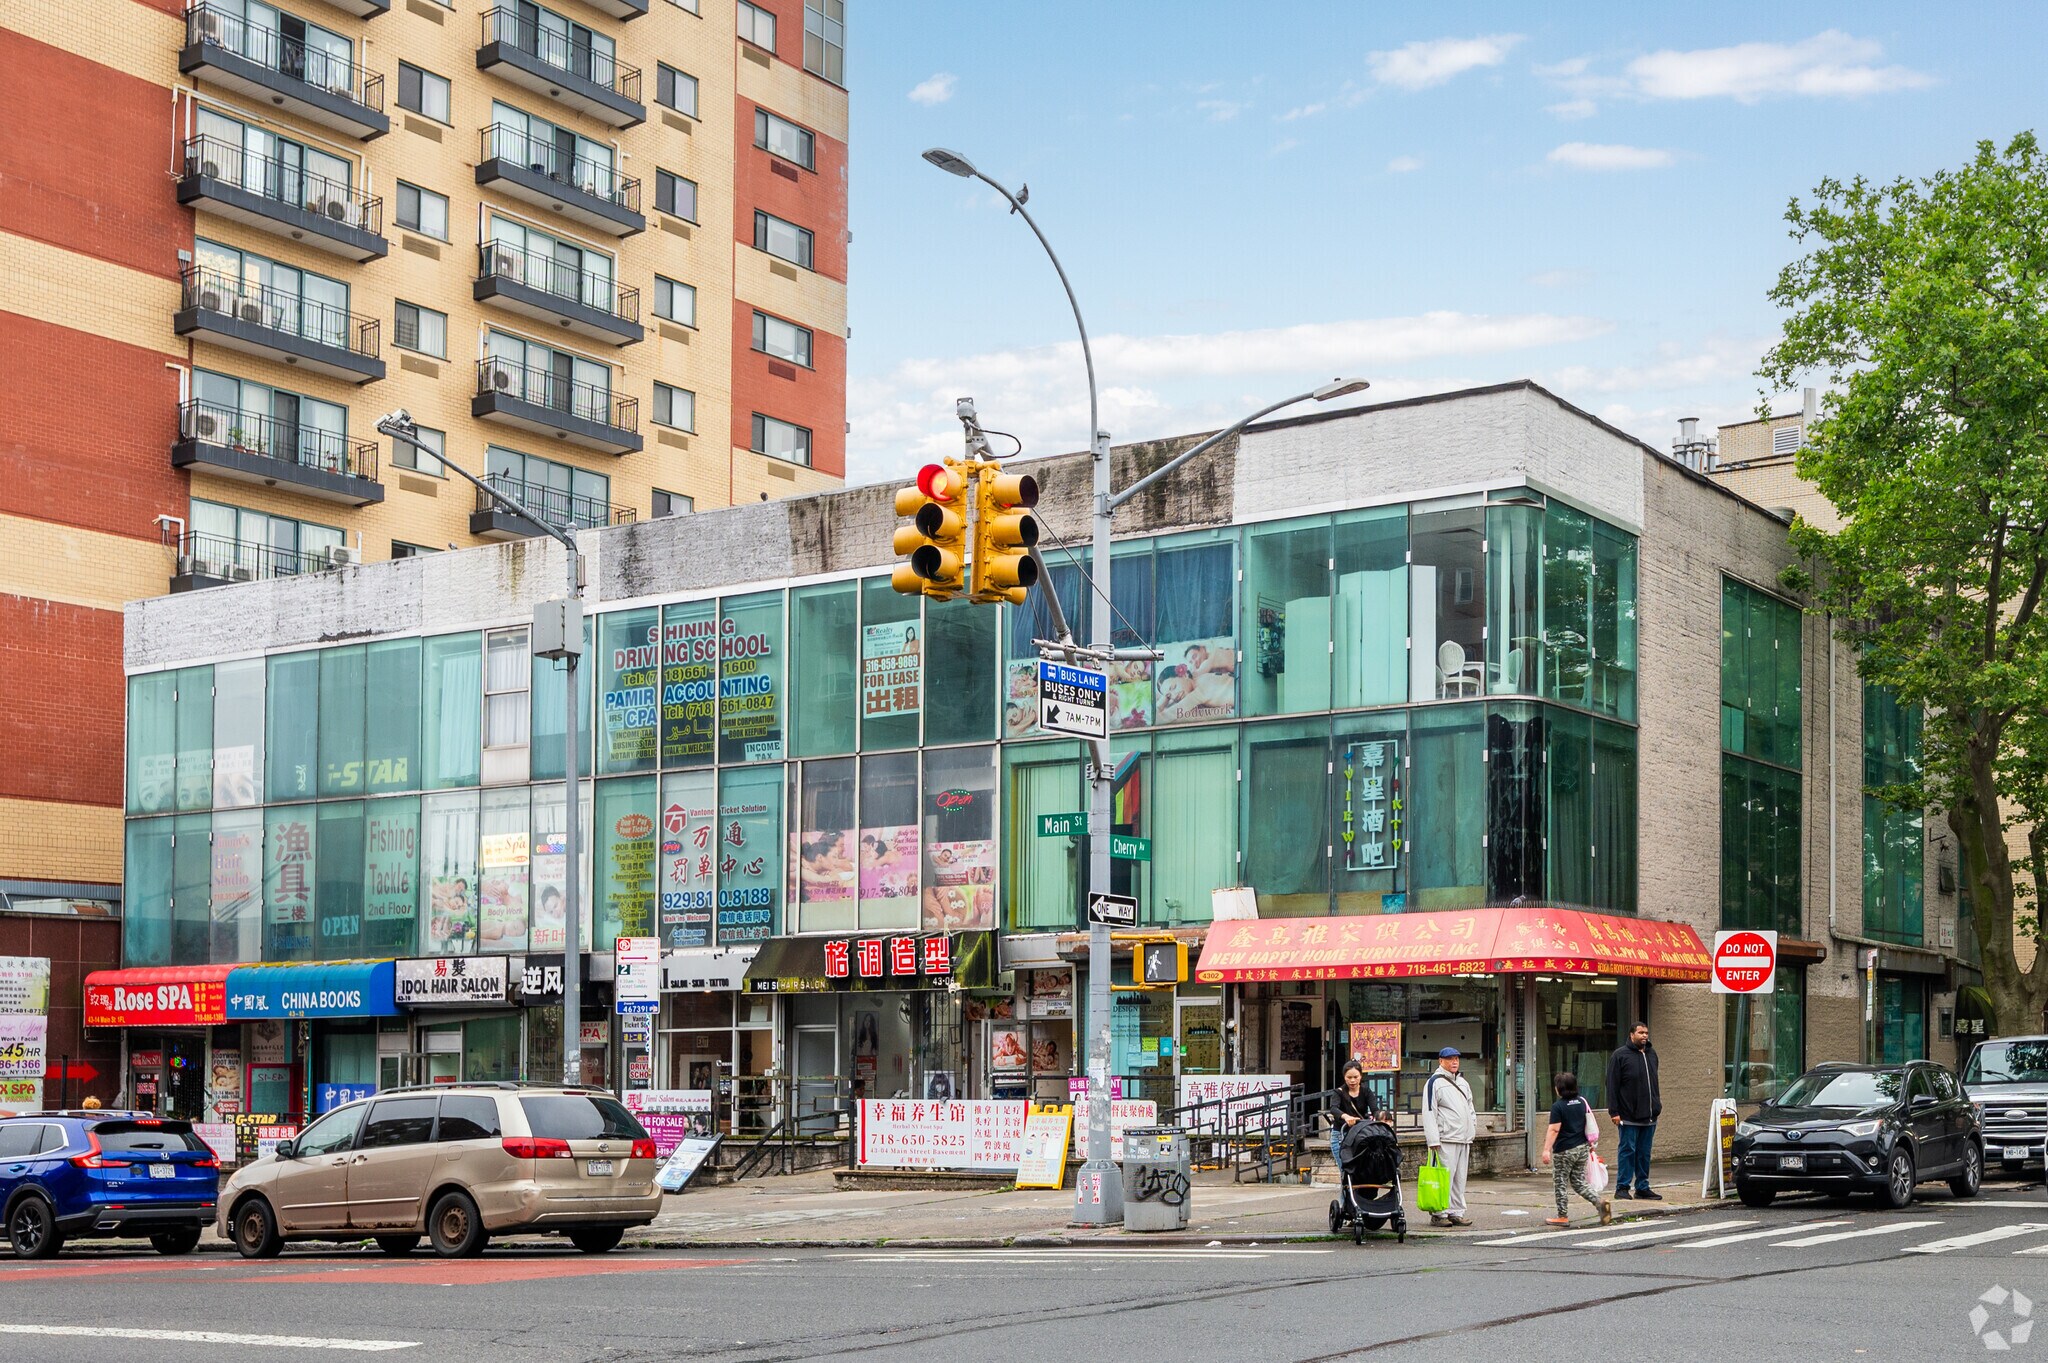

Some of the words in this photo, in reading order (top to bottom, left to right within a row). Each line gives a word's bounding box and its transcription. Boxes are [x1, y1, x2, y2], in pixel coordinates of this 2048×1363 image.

[648, 619, 735, 642] SHINING
[614, 641, 688, 670] DRIVING
[693, 634, 771, 661] SCHOOL
[866, 655, 918, 673] 516-858-9869
[624, 673, 645, 685] Tel:
[864, 674, 885, 688] FOR
[887, 670, 919, 686] LEASE
[1061, 669, 1077, 683] BUS
[1078, 673, 1100, 687] LANE
[605, 688, 655, 710] PAMIR
[663, 676, 771, 703] ACCOUNTING
[1045, 681, 1076, 697] BUSES
[1078, 688, 1102, 702] ONLY
[866, 686, 919, 715] 出租
[1059, 694, 1075, 703] RIGHT
[1076, 697, 1095, 707] TURNS
[609, 713, 622, 722] IRS
[627, 708, 657, 727] CPA
[664, 706, 684, 718] Tel:
[1066, 711, 1101, 727] 7AM-7PM
[722, 717, 736, 727] FORM
[737, 714, 775, 725] CORPORATION
[616, 730, 640, 739] INCOME
[642, 729, 653, 737] TAX
[729, 728, 743, 739] BOOK
[745, 727, 767, 736] KEEPING
[613, 741, 643, 750] BUSINESS
[645, 739, 656, 748] TAX
[688, 743, 714, 753] WELCOME
[746, 742, 780, 753] INCOME
[937, 792, 973, 807] Open
[1361, 743, 1385, 865] 嘉星酒吧
[721, 805, 740, 814] Ticket
[741, 804, 767, 813] Solution
[1045, 817, 1070, 834] Main
[1075, 815, 1083, 826] St
[369, 820, 414, 859] Fishing
[636, 852, 654, 860] Ticket
[1113, 839, 1137, 859] Cherry
[1139, 842, 1145, 851] Av
[214, 854, 242, 869] Hair
[369, 862, 409, 895] Tackle
[615, 872, 652, 881] Immigration
[613, 892, 638, 900] Personal
[368, 903, 385, 916] 2nd
[388, 901, 412, 915] Floor
[487, 907, 505, 917] Body
[506, 906, 523, 915] Work
[1097, 903, 1110, 915] ONE
[1118, 905, 1132, 918] WAY
[687, 914, 710, 922] Welcome
[322, 915, 360, 936] OPEN
[692, 929, 706, 937] more
[1208, 951, 1245, 966] NEW
[1247, 949, 1300, 964] HAPPY
[1302, 947, 1349, 962] HOME
[1352, 944, 1442, 961] FURNITURE
[1445, 942, 1480, 956] INC.
[1726, 944, 1741, 953] DO
[1744, 944, 1764, 953] NOT
[825, 937, 950, 978] 格调造型
[621, 965, 628, 974] 2
[1291, 967, 1337, 979] 床上用品
[1407, 961, 1485, 975] 718-461-6823
[1726, 971, 1760, 980] ENTER
[401, 979, 428, 994] IDOL
[431, 978, 458, 994] HAIR
[461, 976, 499, 993] SALON
[521, 966, 564, 995] 逆风
[671, 980, 687, 988] SALON
[709, 979, 729, 987] TATTOO
[757, 981, 770, 990] MEI
[779, 980, 799, 990] HAIR
[800, 980, 826, 990] SALON
[114, 987, 153, 1011] Rose
[157, 985, 192, 1010] SPA
[231, 994, 269, 1011] 中國風
[282, 992, 318, 1010] CHINA
[320, 991, 361, 1008] BOOKS
[100, 1015, 110, 1023] Main
[11, 1084, 36, 1094] SPA
[1070, 1080, 1085, 1089] 出租
[659, 1094, 674, 1103] Salon
[871, 1102, 966, 1122] 幸福养生馆
[652, 1117, 665, 1126] FOR
[666, 1117, 683, 1127] SALE
[260, 1127, 268, 1138] FOR
[269, 1127, 280, 1138] RENT
[871, 1133, 965, 1147] 718-650-5825
[974, 1153, 1020, 1162] 四季护理仪
